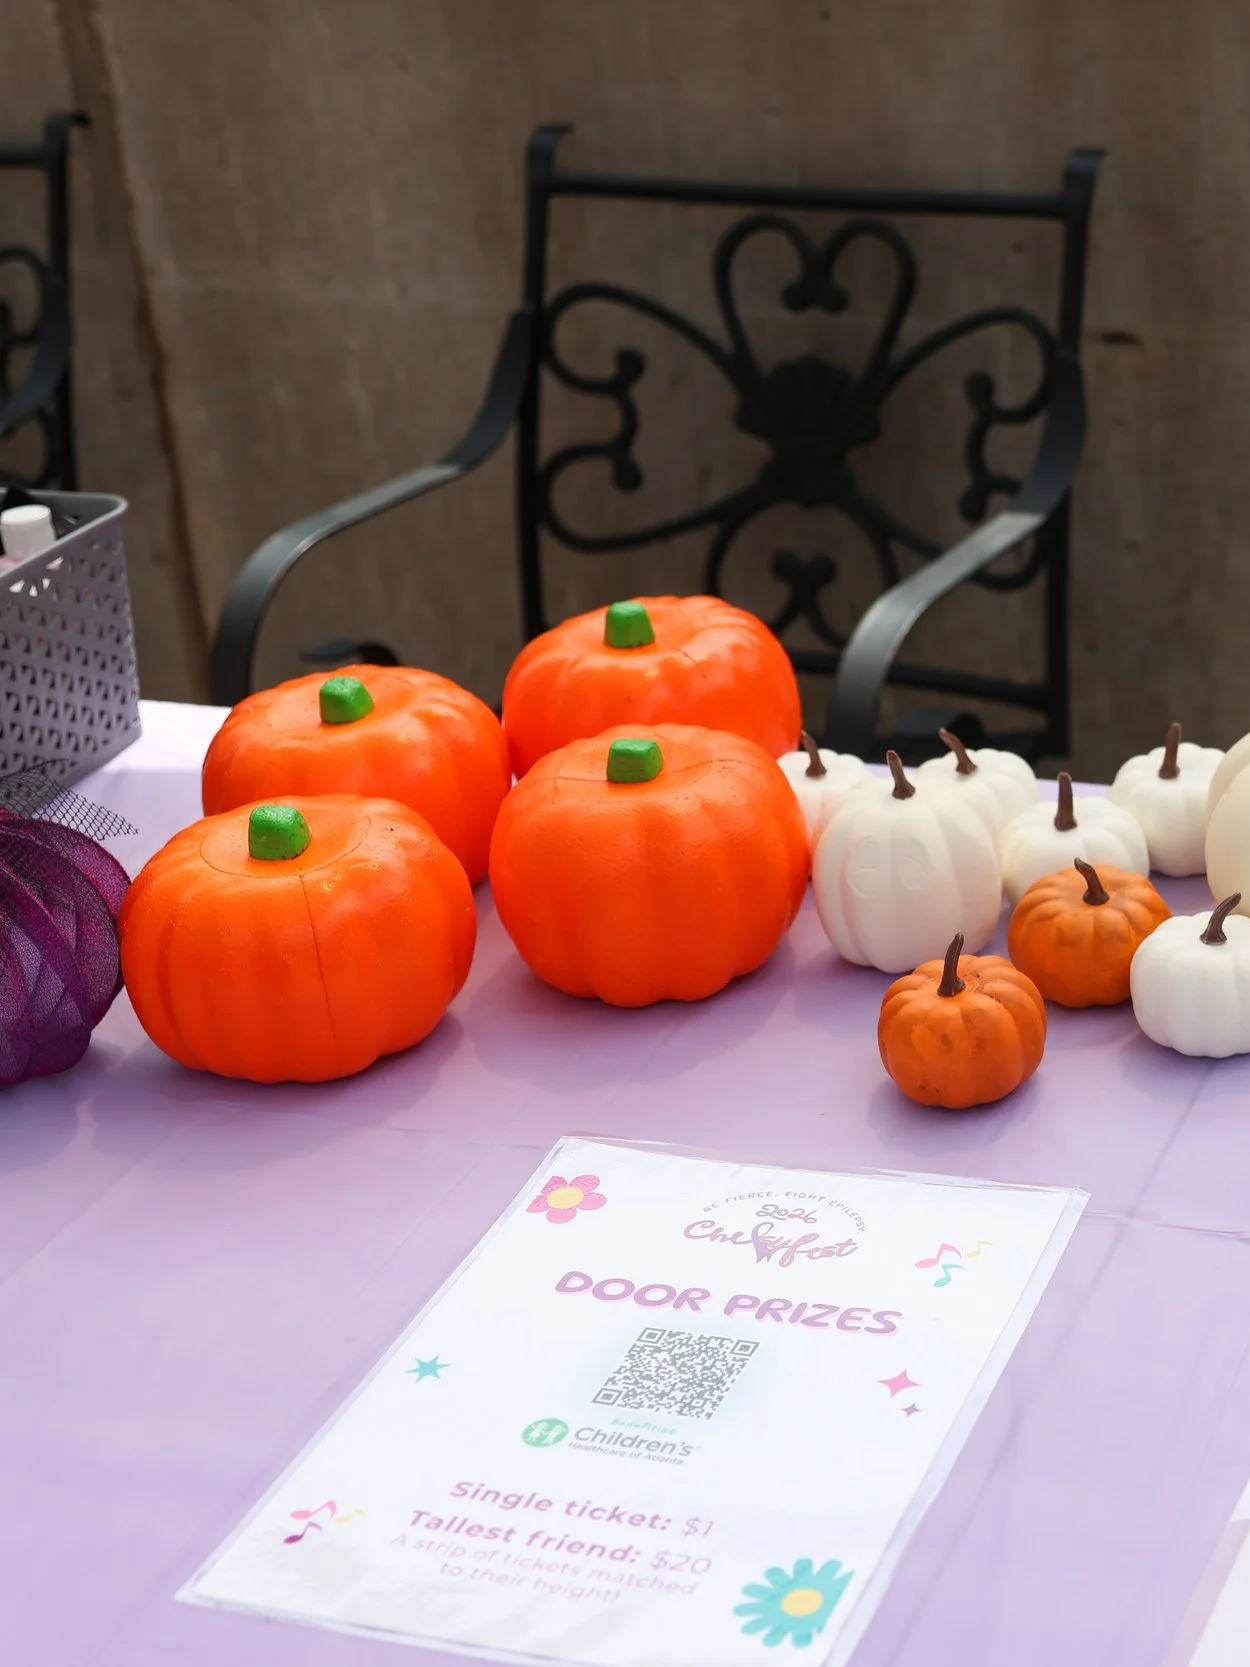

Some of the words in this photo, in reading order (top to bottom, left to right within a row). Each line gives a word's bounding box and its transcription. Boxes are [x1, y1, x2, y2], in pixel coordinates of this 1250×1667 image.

[703, 1203, 720, 1213] BE
[725, 1191, 779, 1204] FIERCE.
[785, 1191, 826, 1202] FIGHT
[756, 1204, 818, 1224] 2026
[555, 1271, 711, 1314] DOOR
[723, 1294, 903, 1336] PRIZES
[568, 1441, 626, 1458] Healthcare
[644, 1453, 684, 1466] Atlanta
[574, 1427, 694, 1457] Children's
[449, 1481, 553, 1512] Single
[564, 1499, 673, 1532] ticket:
[681, 1517, 714, 1538] $1
[407, 1510, 516, 1545] Tallest
[525, 1530, 642, 1565] friend:
[650, 1550, 712, 1576] $20
[390, 1534, 407, 1548] A
[413, 1537, 467, 1559] strip
[473, 1547, 500, 1563] of
[502, 1551, 582, 1579] tickets
[586, 1570, 698, 1597] matched
[440, 1563, 463, 1578] to
[470, 1565, 528, 1590] their
[532, 1576, 621, 1605] height!
